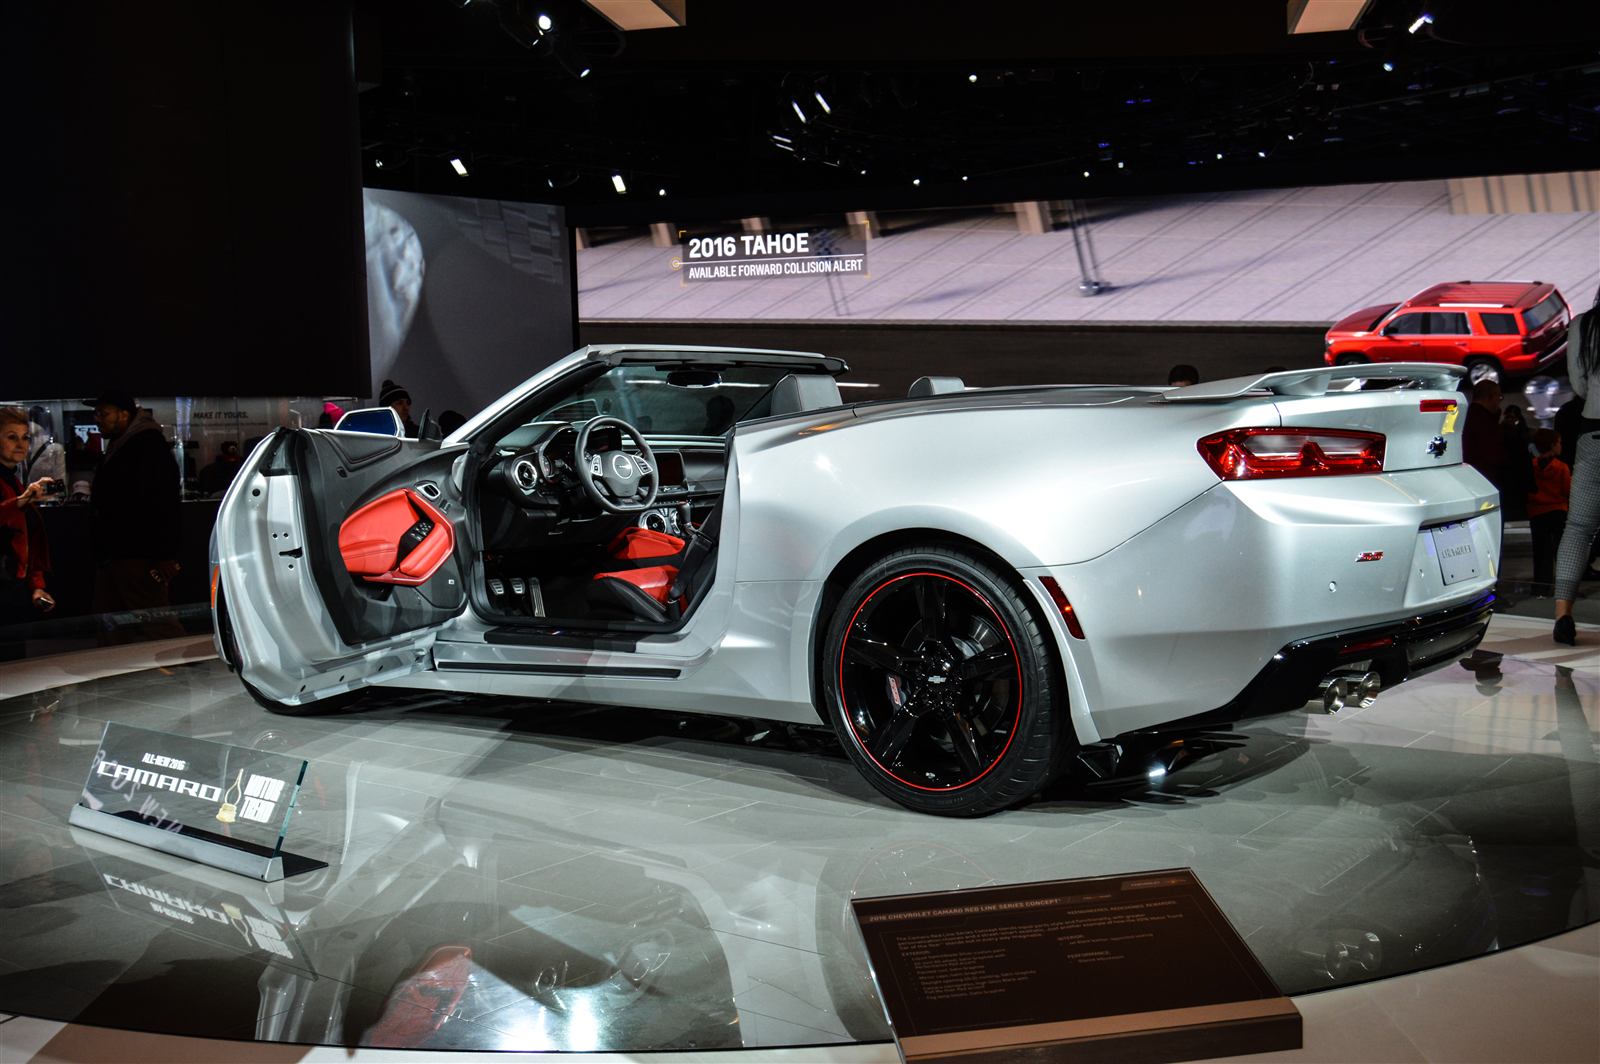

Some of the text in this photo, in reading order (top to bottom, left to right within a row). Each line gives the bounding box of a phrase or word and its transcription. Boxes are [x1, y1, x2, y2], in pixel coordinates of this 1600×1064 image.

[688, 232, 810, 259] 2016 TAHOE
[688, 258, 864, 280] AVAILABLE FORWARD COLLISION ALERT
[193, 411, 213, 419] MAKE
[214, 411, 222, 419] IT
[97, 760, 223, 802] CAMARO
[888, 911, 931, 920] CHEVROLET
[932, 907, 963, 916] CAMARO
